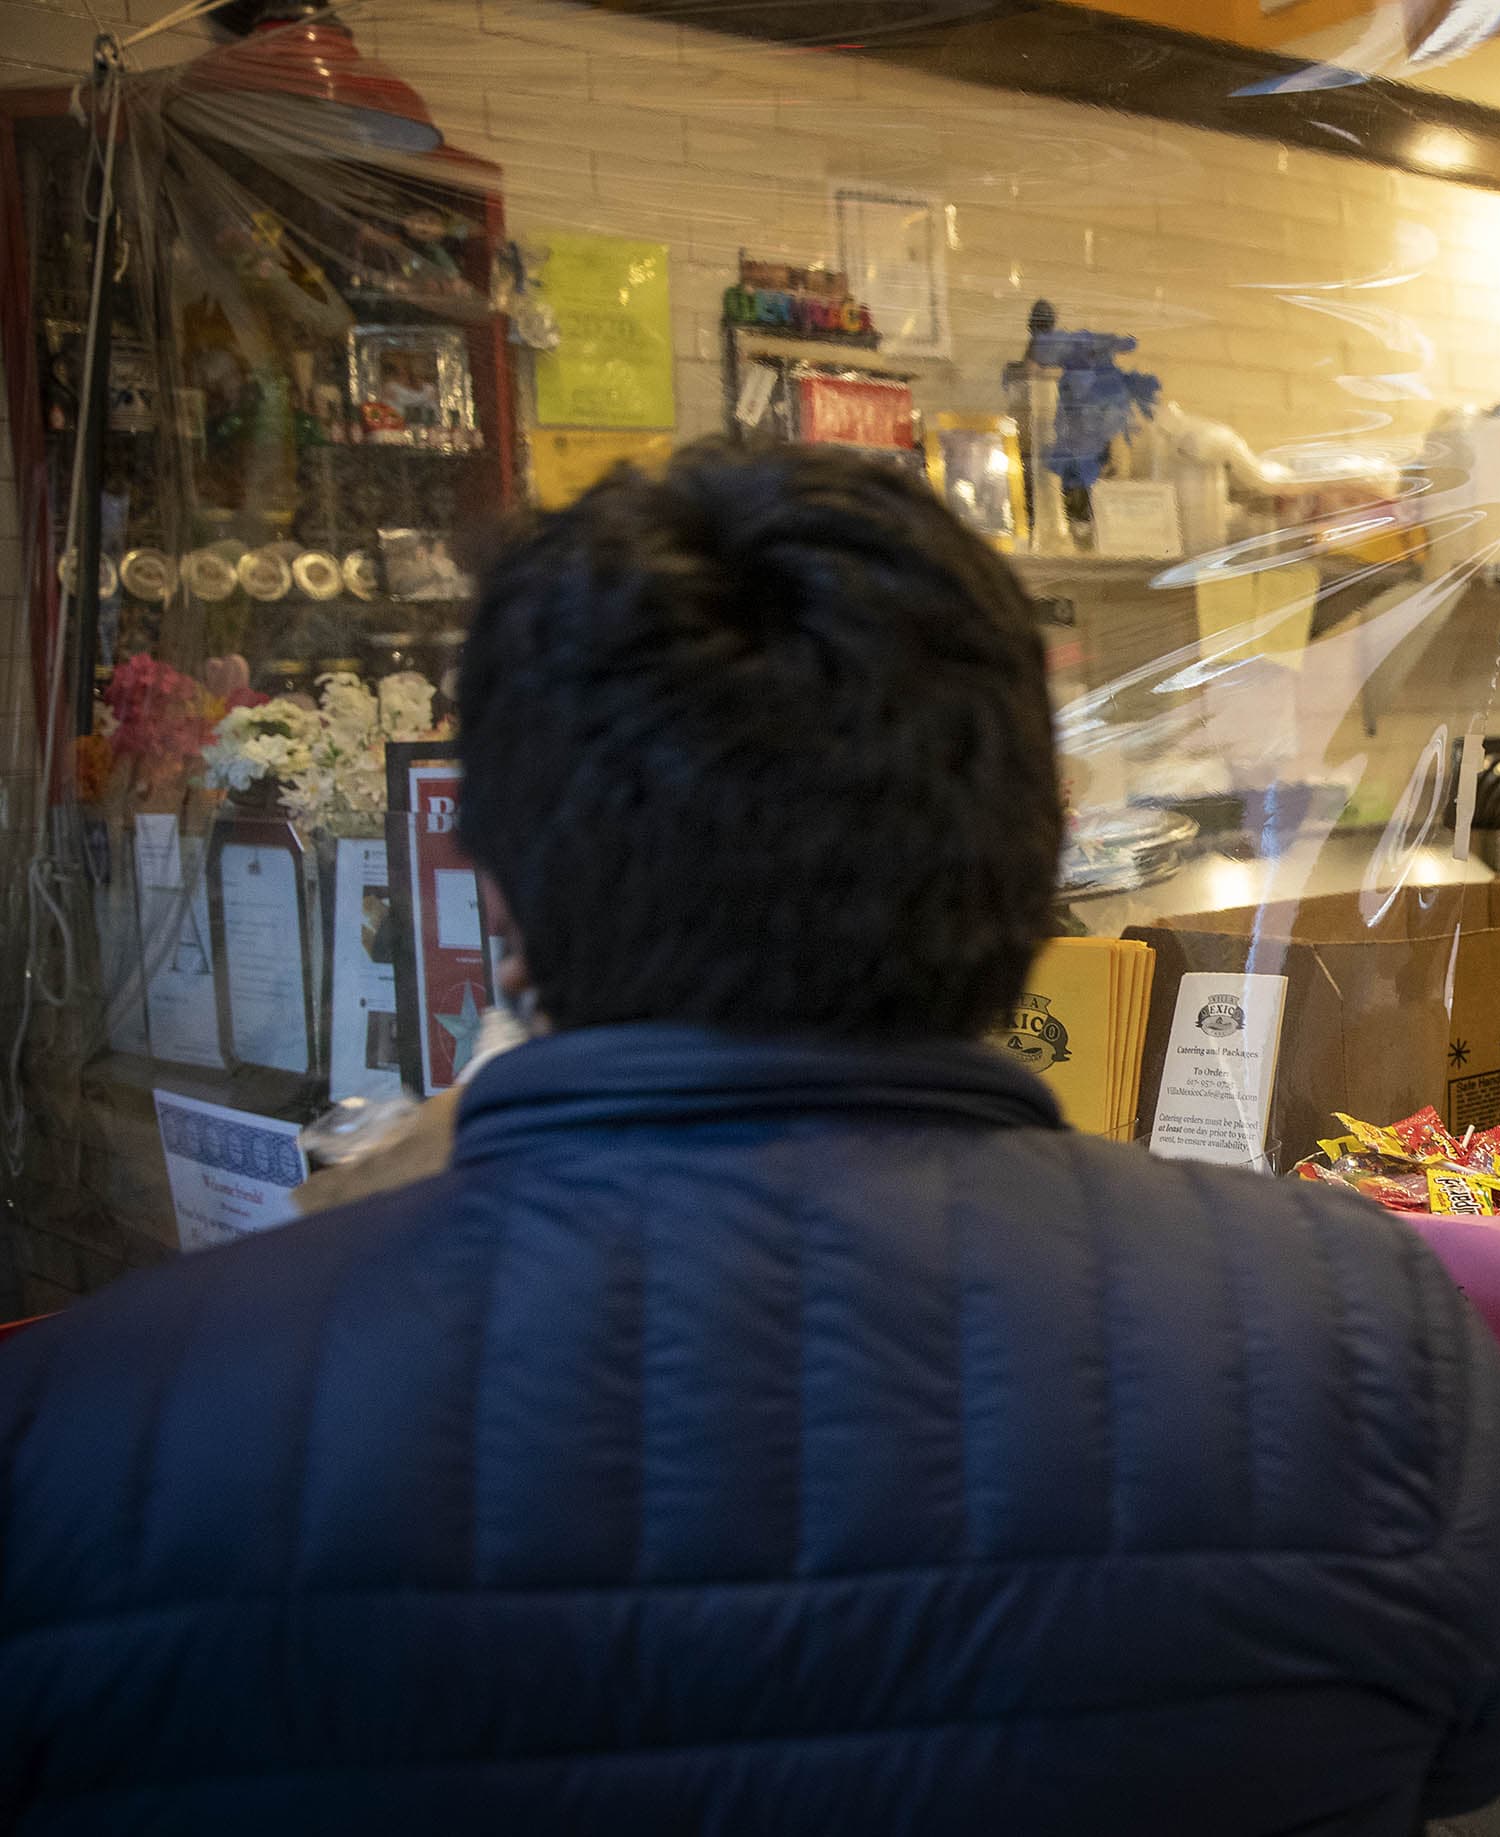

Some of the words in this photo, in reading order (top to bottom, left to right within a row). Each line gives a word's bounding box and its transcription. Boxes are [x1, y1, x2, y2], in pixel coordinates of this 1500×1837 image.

[1177, 1045, 1205, 1056] Catering
[1222, 1047, 1259, 1059] Packages
[1193, 1067, 1202, 1075] To
[1159, 1113, 1183, 1123] Catering
[1183, 1114, 1204, 1125] orders
[1205, 1117, 1222, 1126] must
[1223, 1117, 1233, 1127] be
[1165, 1124, 1182, 1134] least
[1183, 1127, 1196, 1135] one
[1196, 1127, 1208, 1137] day
[1209, 1129, 1228, 1138] prior
[1229, 1129, 1237, 1138] to
[1184, 1138, 1207, 1147] ensure
